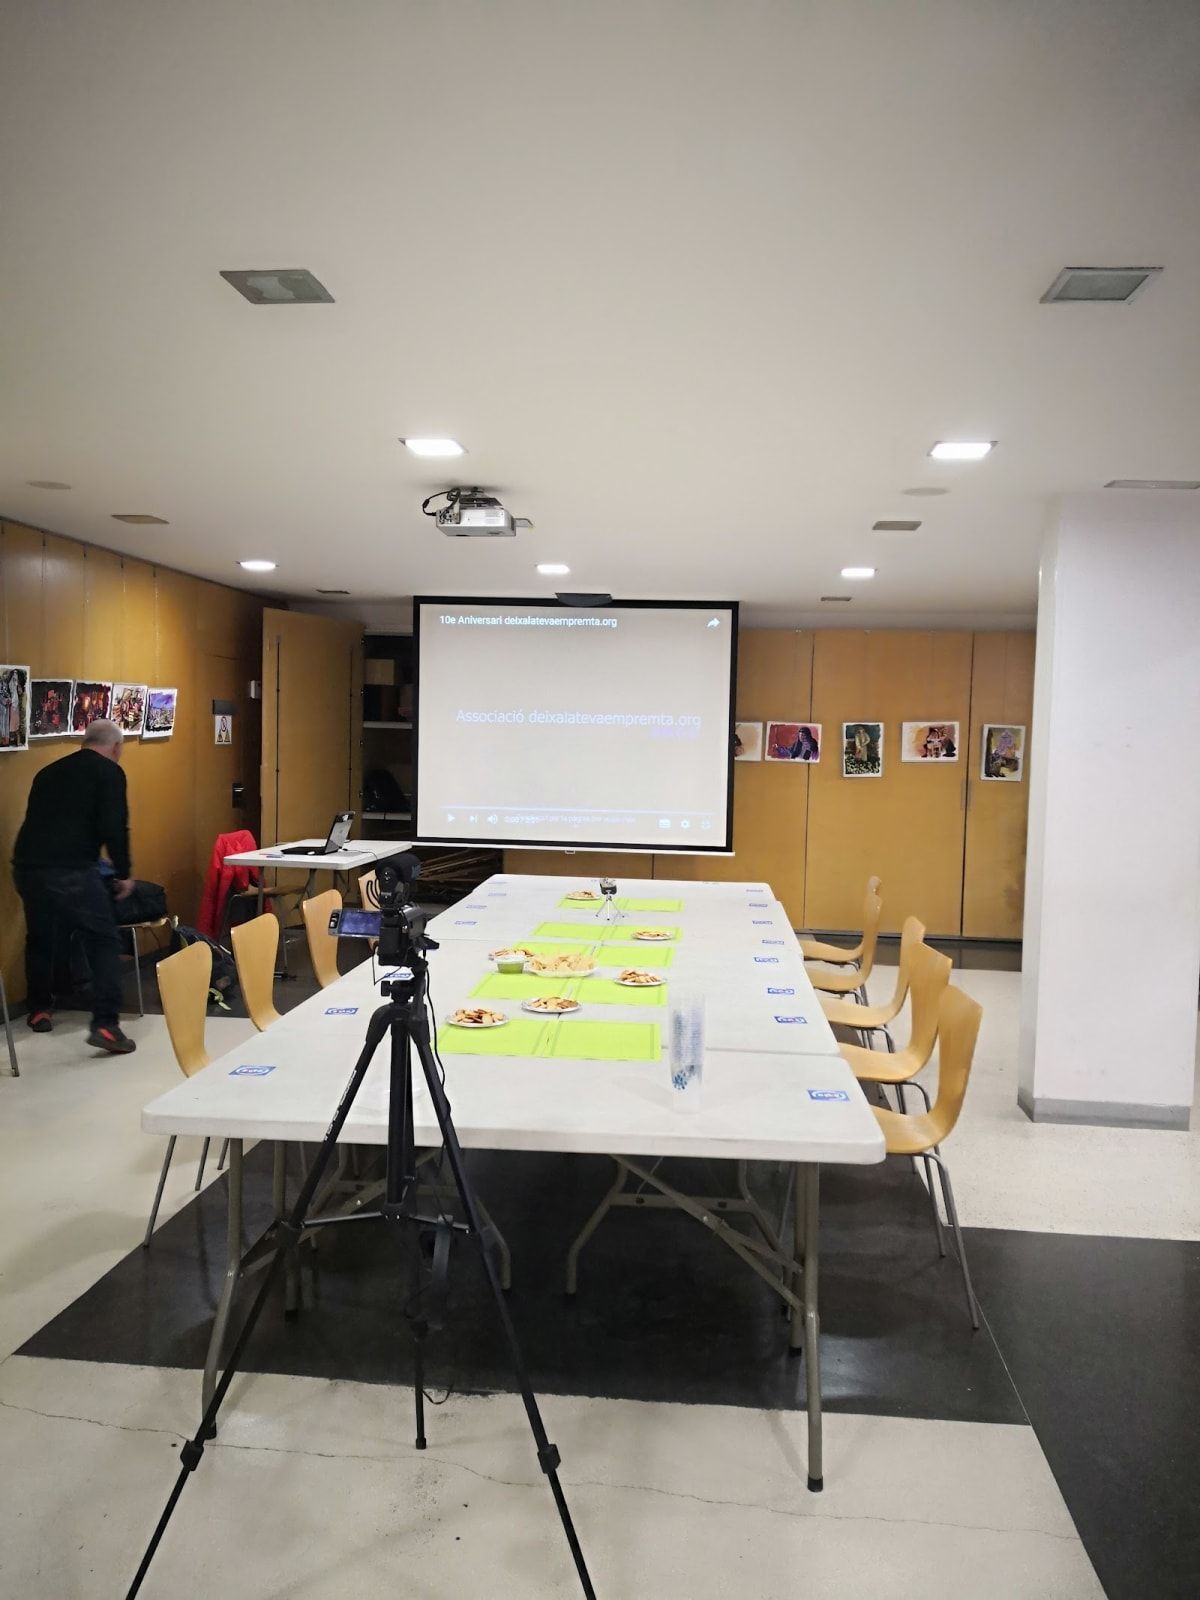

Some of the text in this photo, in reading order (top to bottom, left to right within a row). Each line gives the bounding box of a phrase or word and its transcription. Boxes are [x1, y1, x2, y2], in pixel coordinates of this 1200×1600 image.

[439, 615, 618, 627] 10e Aniversari deixalatevaempremta.org
[456, 709, 702, 727] Associació deixalatevaempremta.org
